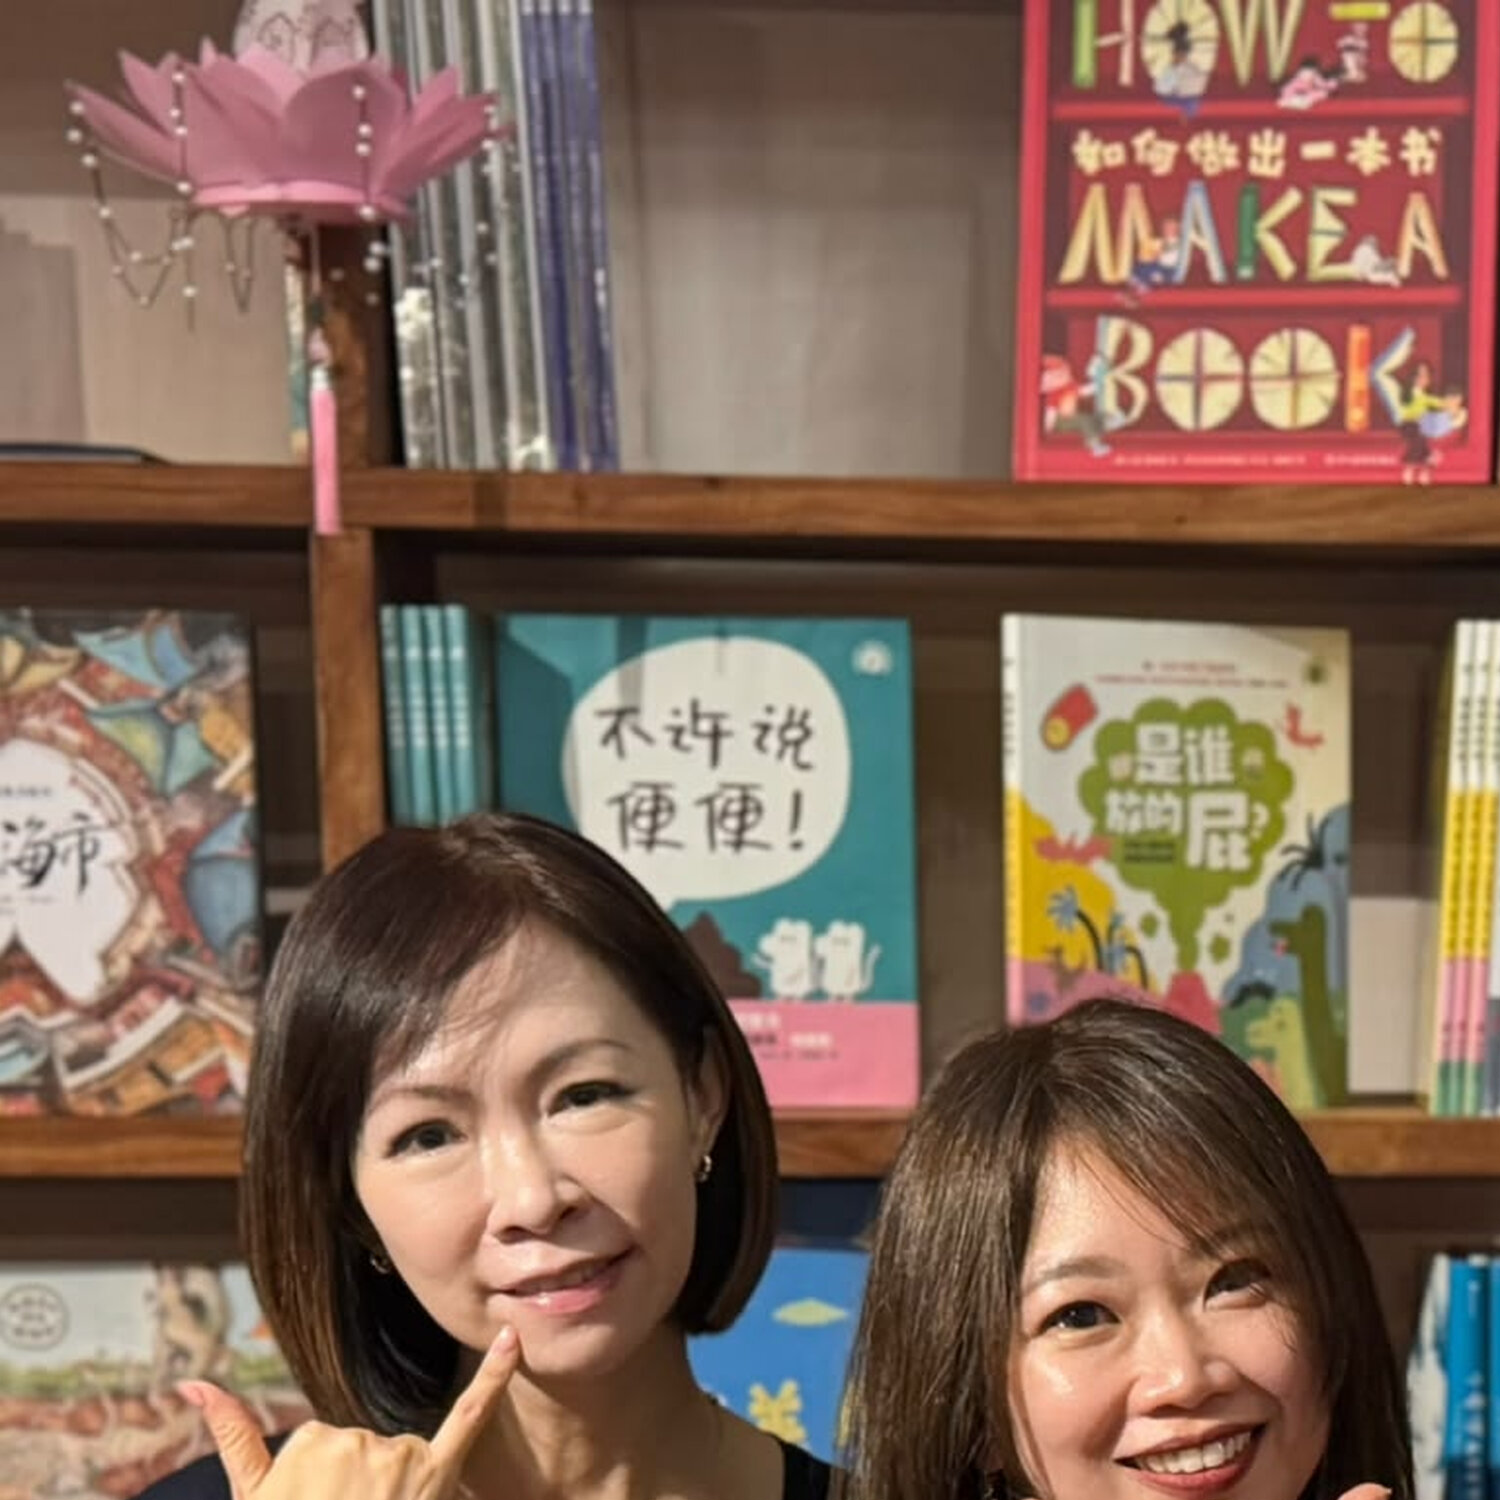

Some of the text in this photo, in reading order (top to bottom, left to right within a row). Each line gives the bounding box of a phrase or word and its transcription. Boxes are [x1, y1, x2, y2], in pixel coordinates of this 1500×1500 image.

[1072, 0, 1302, 90] HOW
[1072, 126, 1443, 178] 如何做出一本书
[1058, 181, 1449, 284] MAKE A
[1095, 314, 1417, 432] BOOK
[594, 698, 817, 770] 不许说
